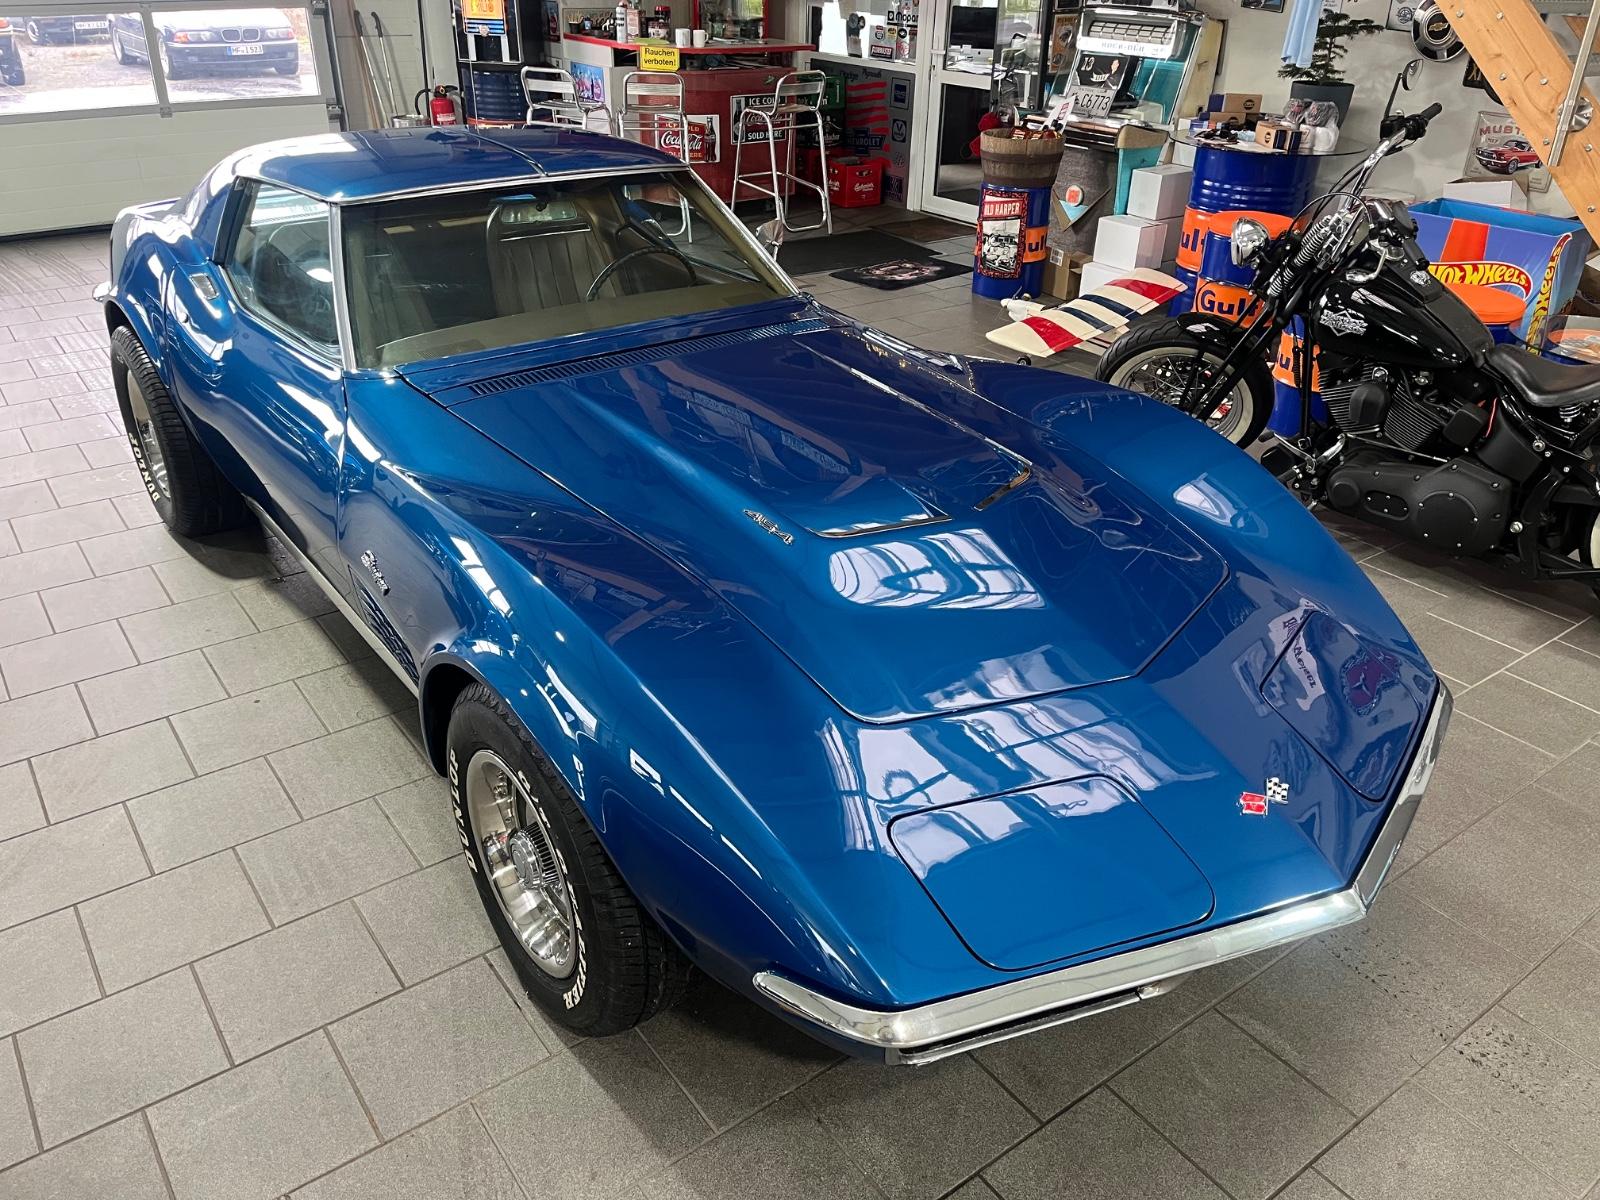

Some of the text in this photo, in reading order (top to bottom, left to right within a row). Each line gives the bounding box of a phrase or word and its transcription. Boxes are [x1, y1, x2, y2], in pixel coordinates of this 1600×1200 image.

[645, 48, 675, 57] Rauchen
[644, 58, 676, 67] verboten!
[749, 97, 760, 105] ICE
[1080, 93, 1111, 110] C6773
[747, 130, 783, 140] SOLD HRE
[995, 202, 1020, 216] HARPER
[128, 432, 161, 502] DUNLOP
[450, 749, 478, 874] DUNLOP
